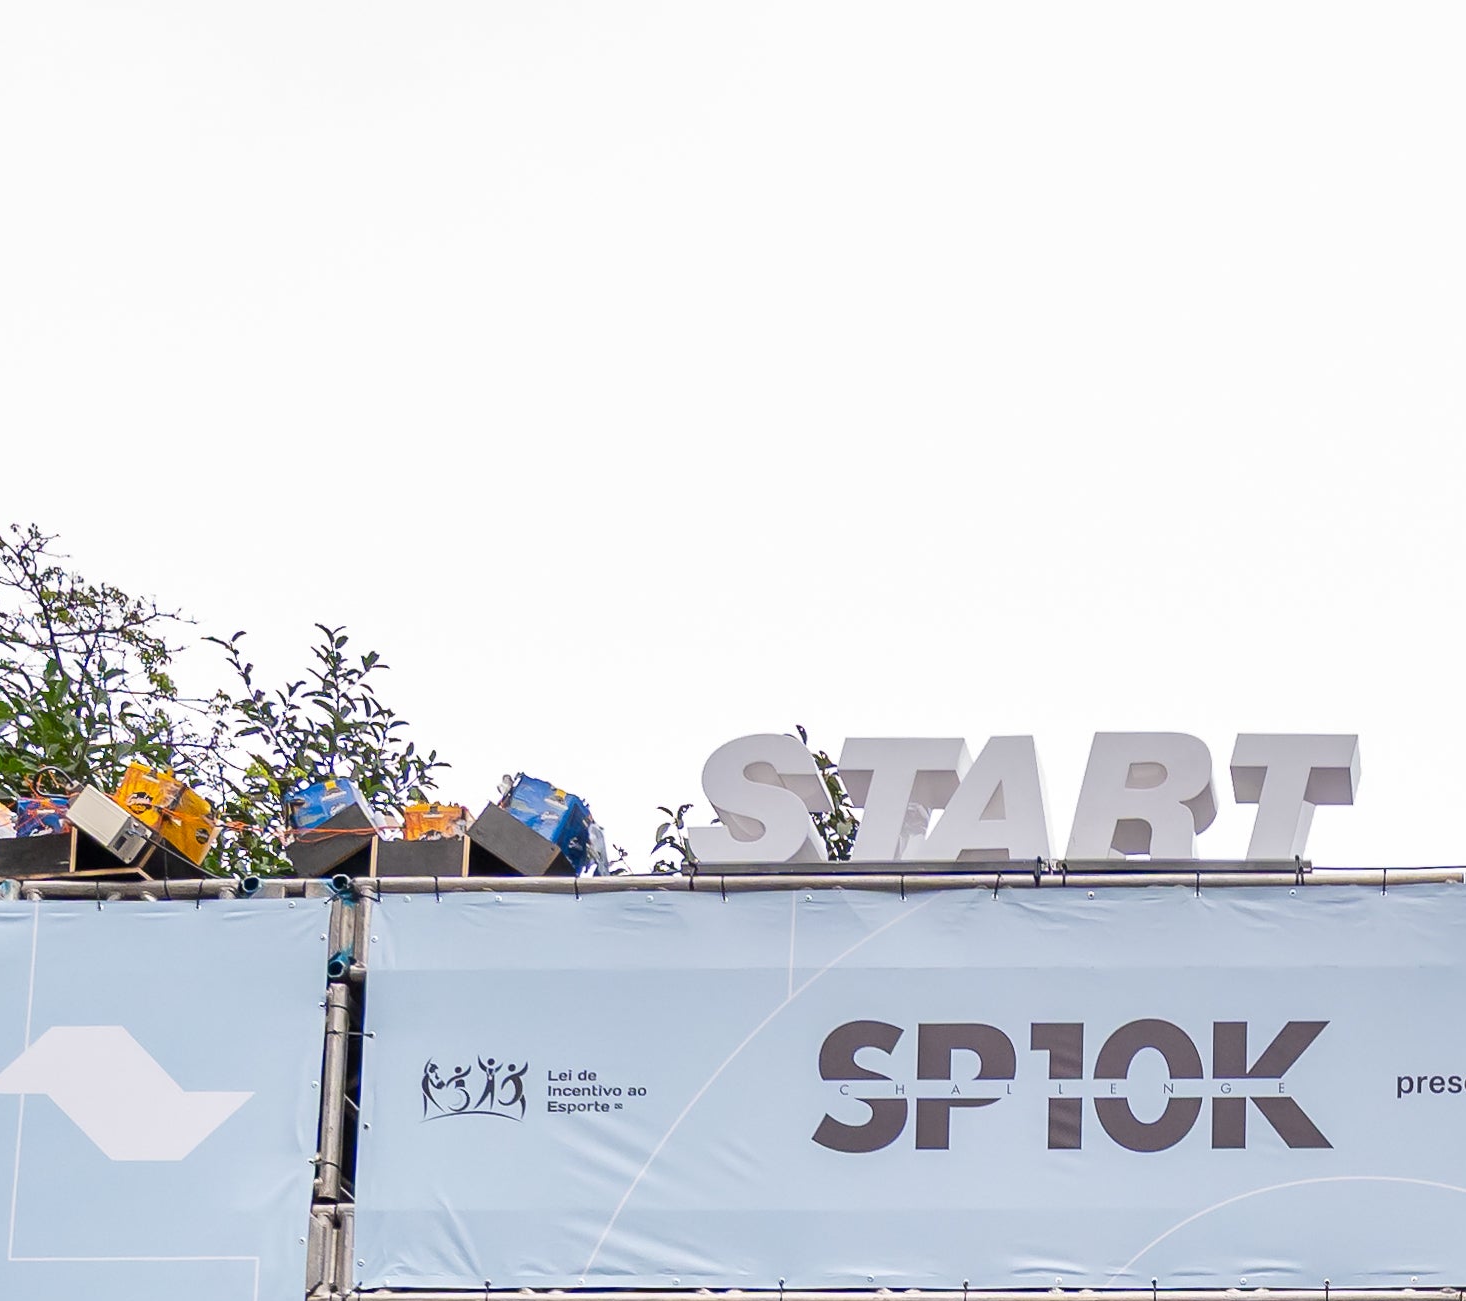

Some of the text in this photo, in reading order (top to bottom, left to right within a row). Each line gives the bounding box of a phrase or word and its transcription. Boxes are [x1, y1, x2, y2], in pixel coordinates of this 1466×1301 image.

[692, 732, 1361, 862] START
[547, 1070, 597, 1081] Lei de
[547, 1085, 647, 1096] Incentivo ao
[810, 1018, 1335, 1154] SP10K
[838, 1081, 1286, 1096] CHALLENGE
[547, 1101, 610, 1114] Esporte
